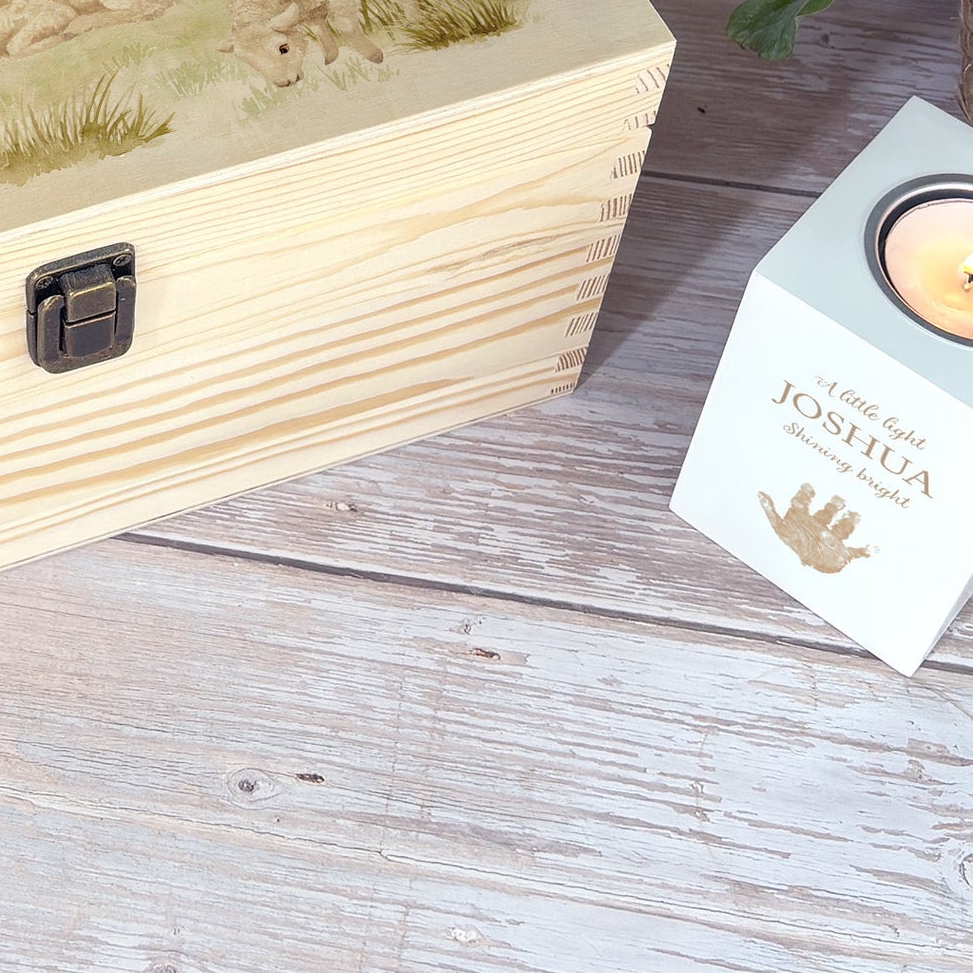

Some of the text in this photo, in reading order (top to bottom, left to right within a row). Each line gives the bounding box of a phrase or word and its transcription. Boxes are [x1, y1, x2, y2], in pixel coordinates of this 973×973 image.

[771, 379, 933, 499] JOSHUA
[815, 375, 929, 450] A little light
[782, 422, 911, 509] Shining bright
